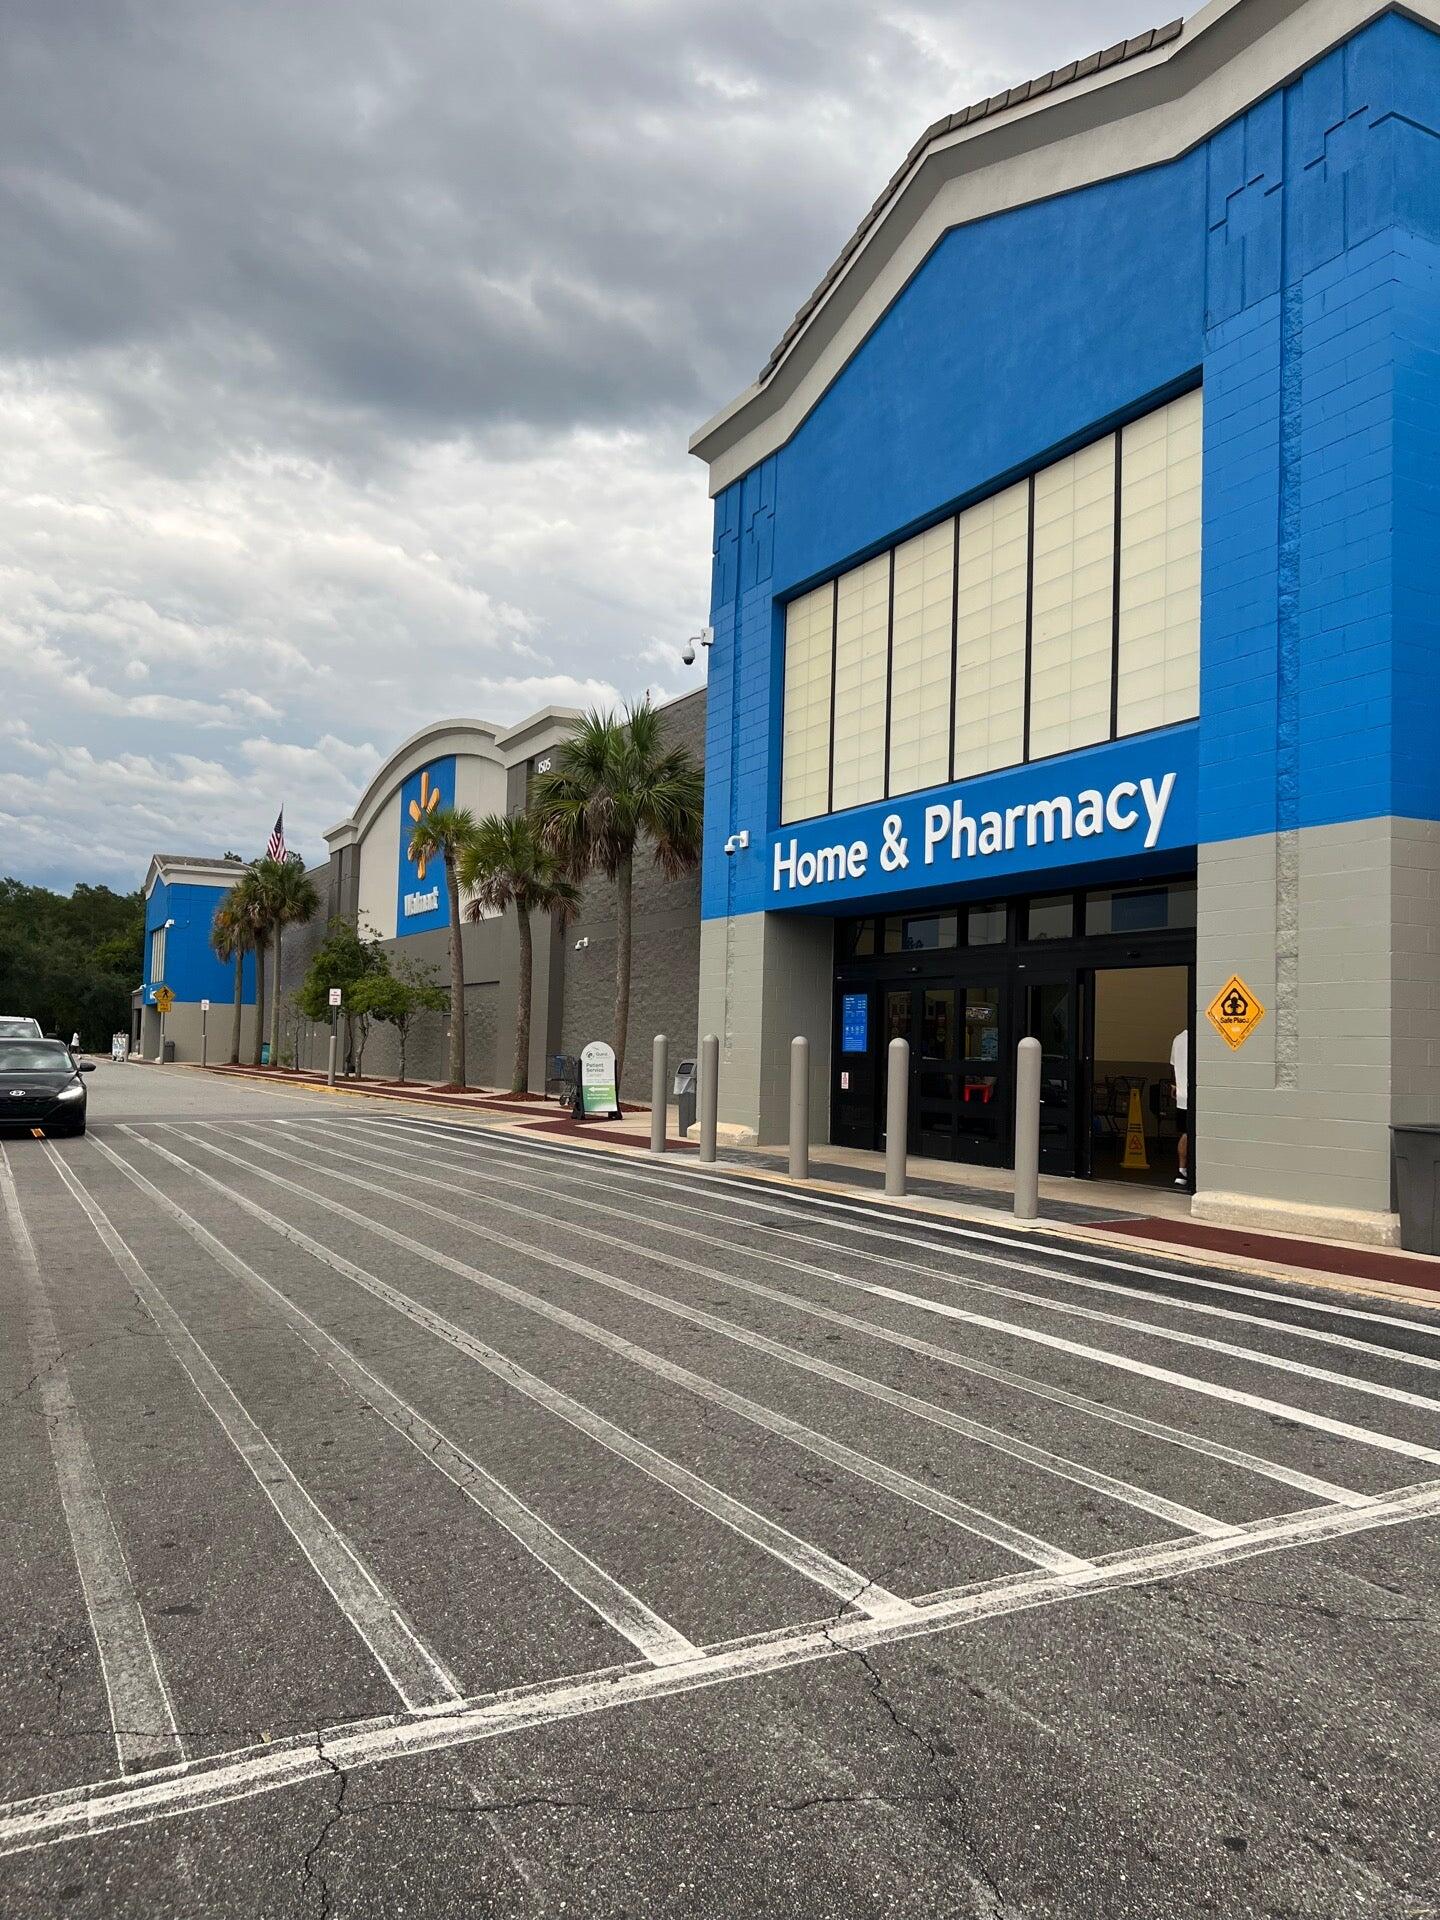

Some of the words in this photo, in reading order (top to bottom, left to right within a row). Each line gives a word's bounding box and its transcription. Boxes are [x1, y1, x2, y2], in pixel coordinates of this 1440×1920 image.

[538, 757, 551, 774] 1505
[773, 838, 867, 891] Home
[880, 814, 909, 872] &
[925, 773, 1177, 864] Pharmacy
